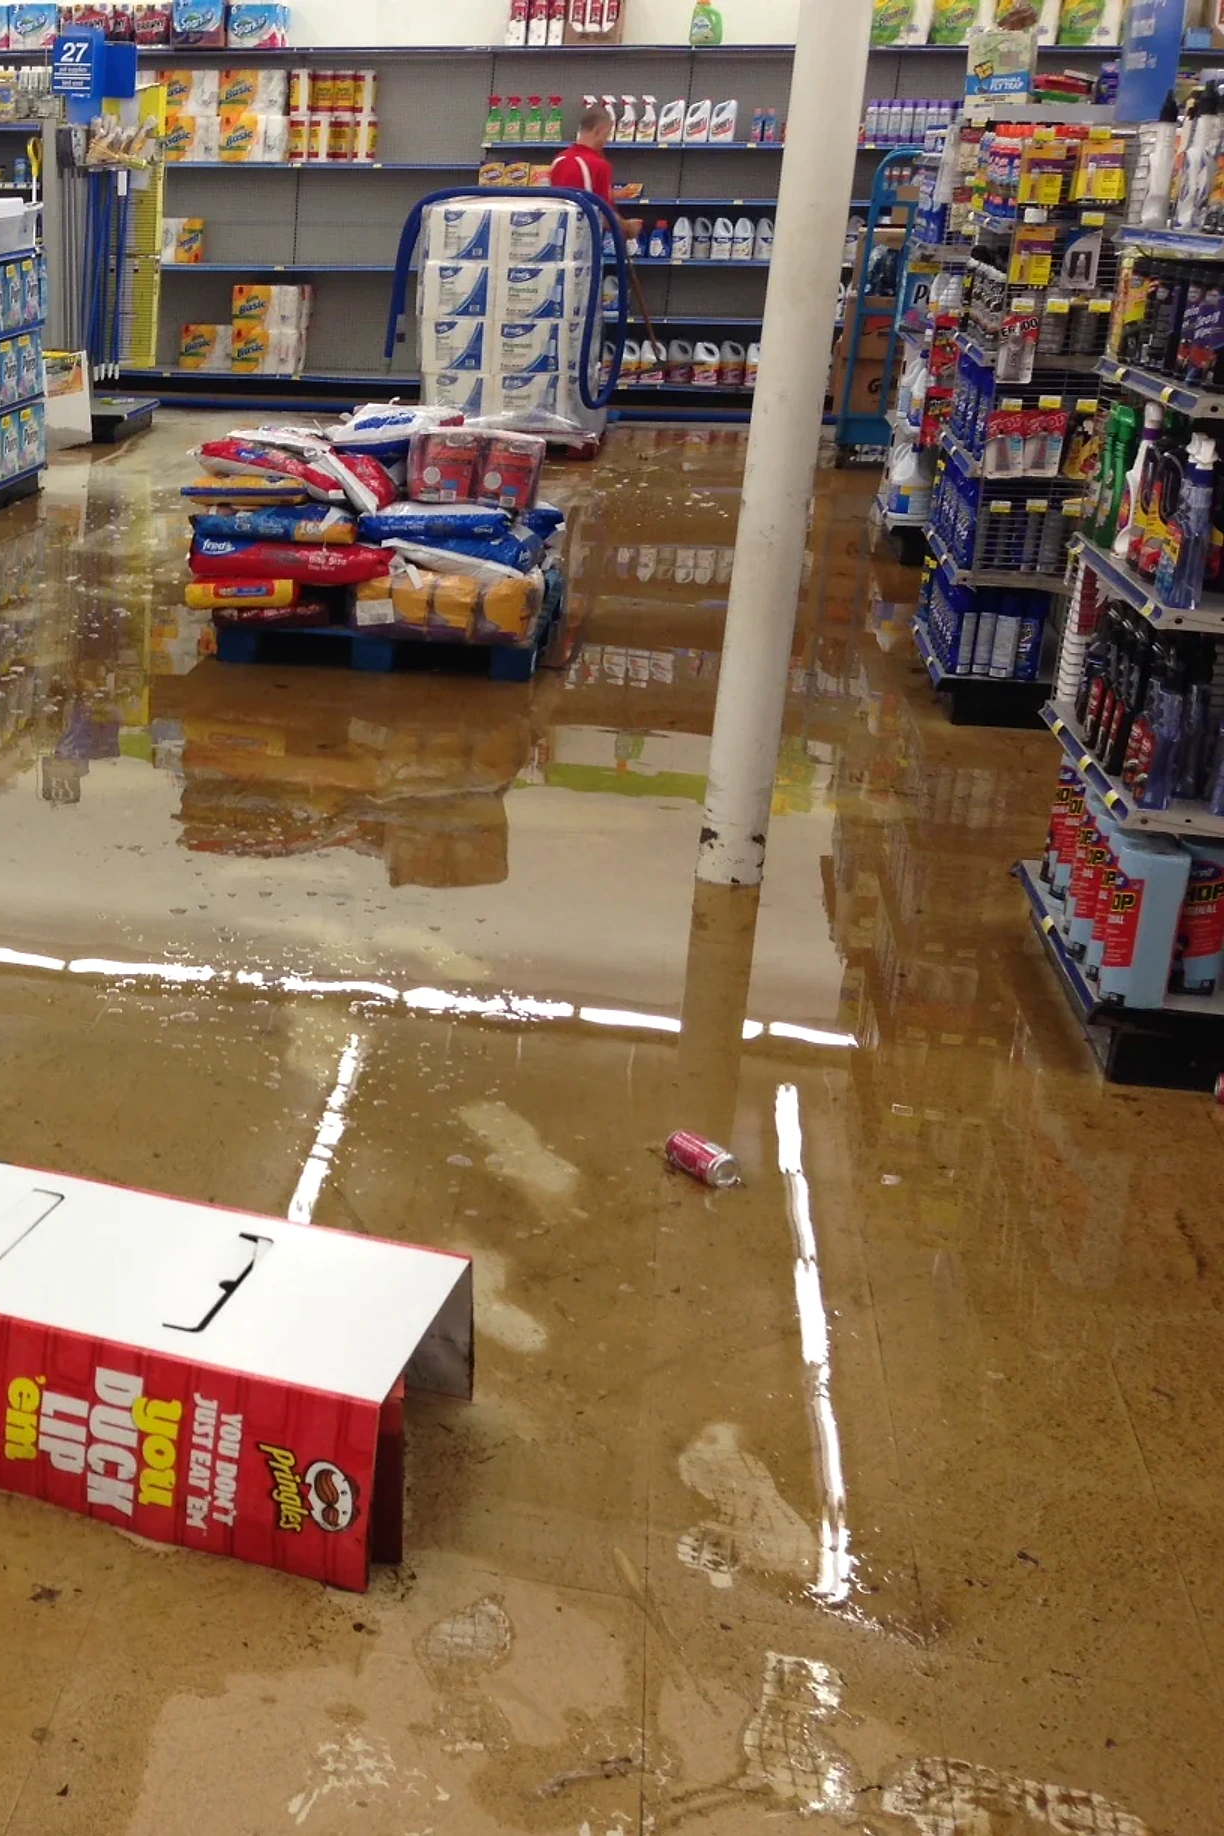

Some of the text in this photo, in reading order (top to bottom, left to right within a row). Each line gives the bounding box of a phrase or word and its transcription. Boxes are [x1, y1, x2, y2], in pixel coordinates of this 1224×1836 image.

[60, 42, 89, 62] 27
[4, 1375, 47, 1460] 'em
[38, 1390, 90, 1475] LIP
[86, 1366, 144, 1517] DUCK
[131, 1396, 182, 1508] you
[192, 1392, 218, 1450] JUST
[188, 1449, 212, 1491] EAT
[213, 1413, 243, 1527] YOU DON'T
[259, 1442, 309, 1533] Pringles
